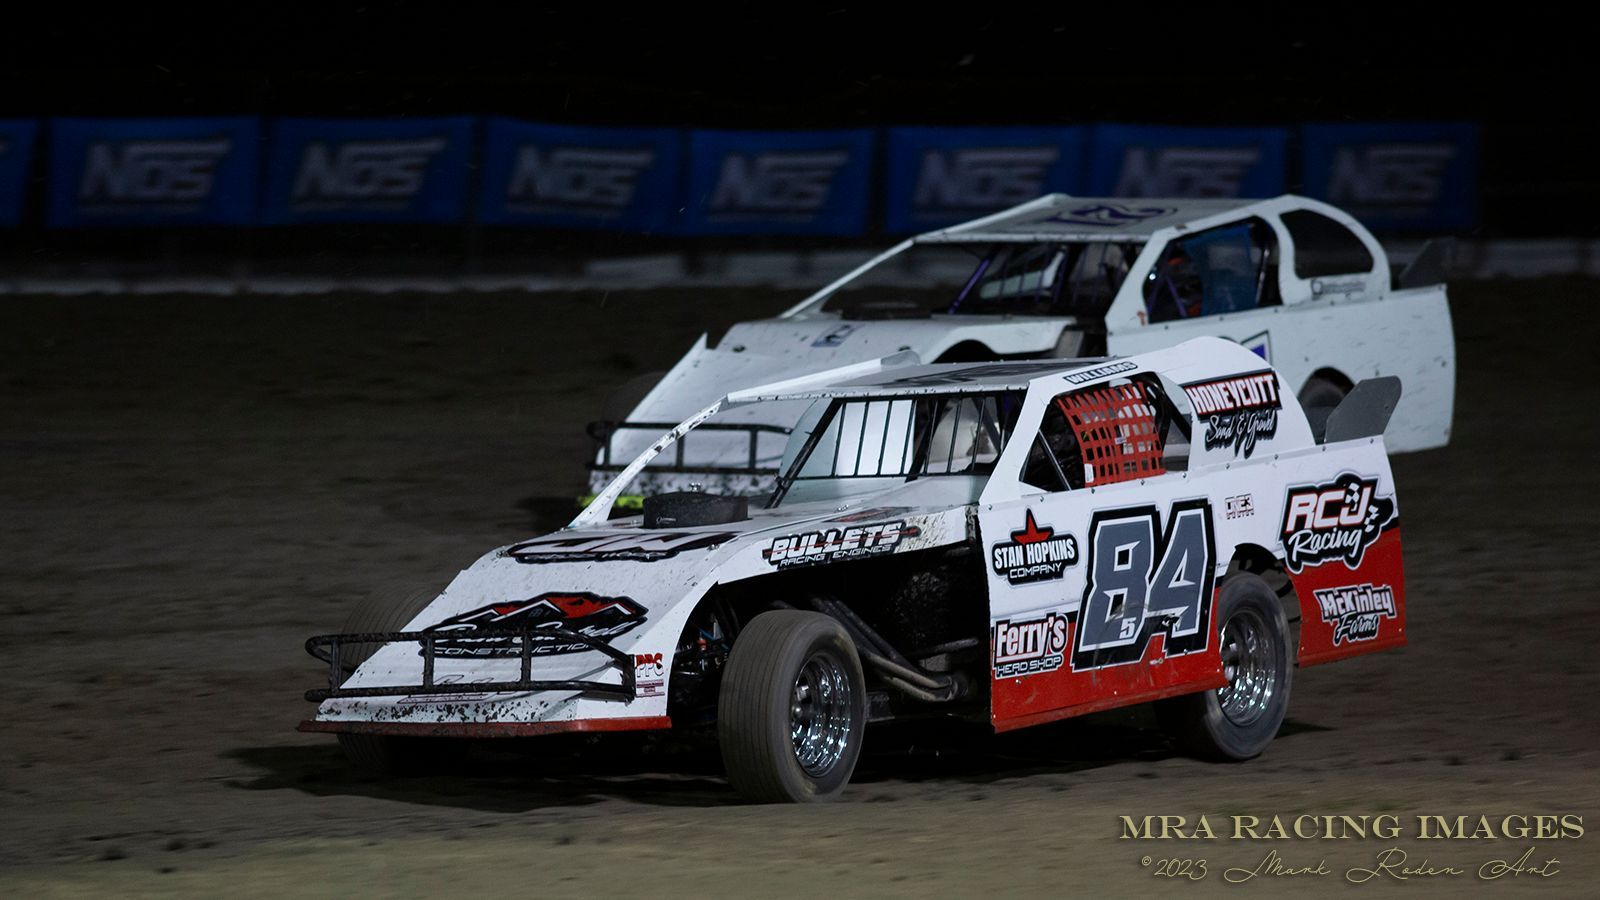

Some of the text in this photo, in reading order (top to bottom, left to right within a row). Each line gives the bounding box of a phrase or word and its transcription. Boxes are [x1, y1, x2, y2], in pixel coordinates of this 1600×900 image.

[78, 137, 234, 200] NOS
[290, 136, 449, 200] NOS
[505, 144, 657, 206] NOS
[710, 148, 851, 208] NOS
[911, 145, 1062, 204] NOS
[1108, 146, 1263, 198] NOS
[1323, 144, 1460, 201] NOS
[1065, 361, 1137, 384] WILLIAMS
[1185, 372, 1278, 415] HONEYCUTT
[1285, 487, 1373, 533] RCJ
[770, 521, 903, 562] BULLETS
[779, 543, 892, 567] RACING ENGINES
[994, 538, 1076, 570] STAN HOPKINS
[1287, 527, 1363, 562] Racing
[1009, 562, 1062, 579] COMPANY
[1078, 507, 1209, 653] 84
[1319, 585, 1395, 618] McKinley
[996, 616, 1067, 658] Ferry's
[1119, 616, 1138, 640] 5
[1336, 611, 1379, 640] Farms
[997, 655, 1062, 676] HEAD SHOP
